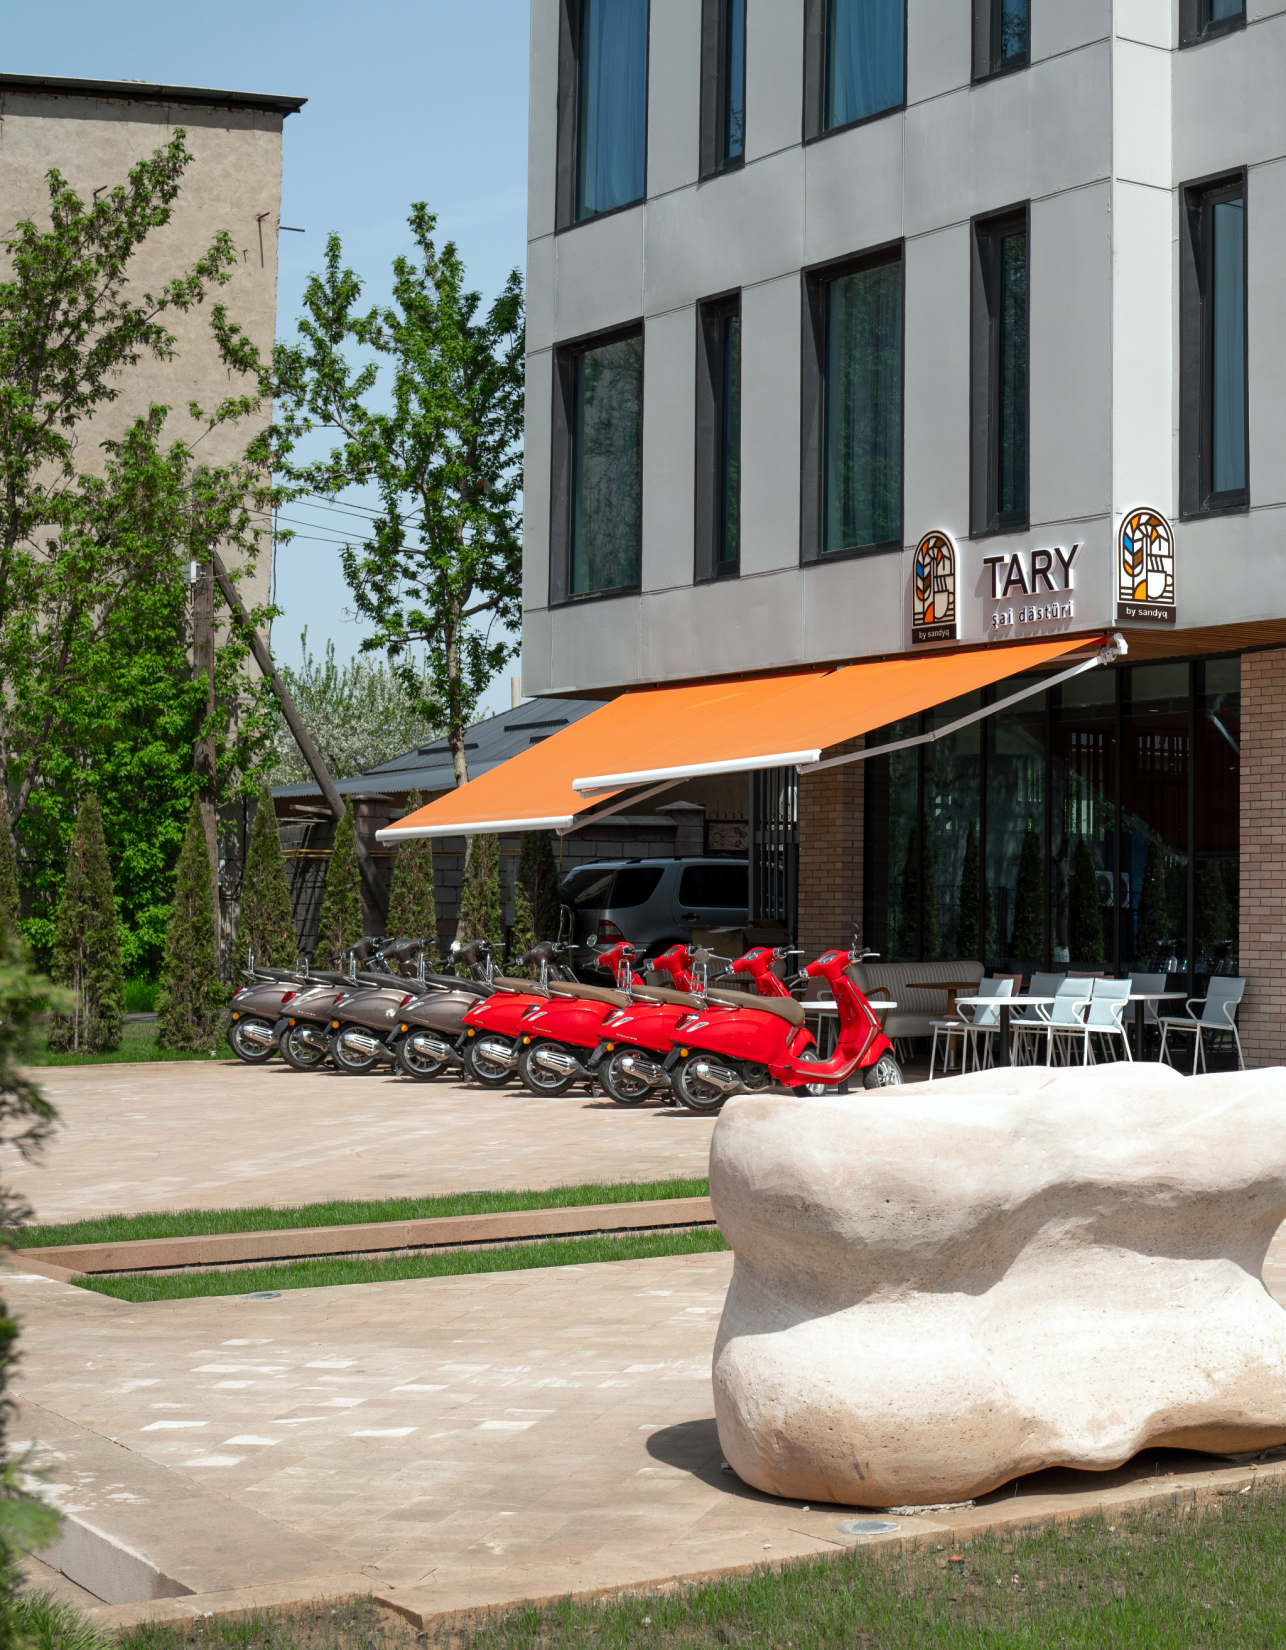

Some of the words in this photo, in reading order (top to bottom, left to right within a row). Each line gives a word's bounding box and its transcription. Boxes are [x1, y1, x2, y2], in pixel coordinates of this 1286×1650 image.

[983, 543, 1083, 599] TARY
[1126, 607, 1136, 616] by
[1138, 609, 1168, 619] sandyq
[918, 631, 927, 640] by
